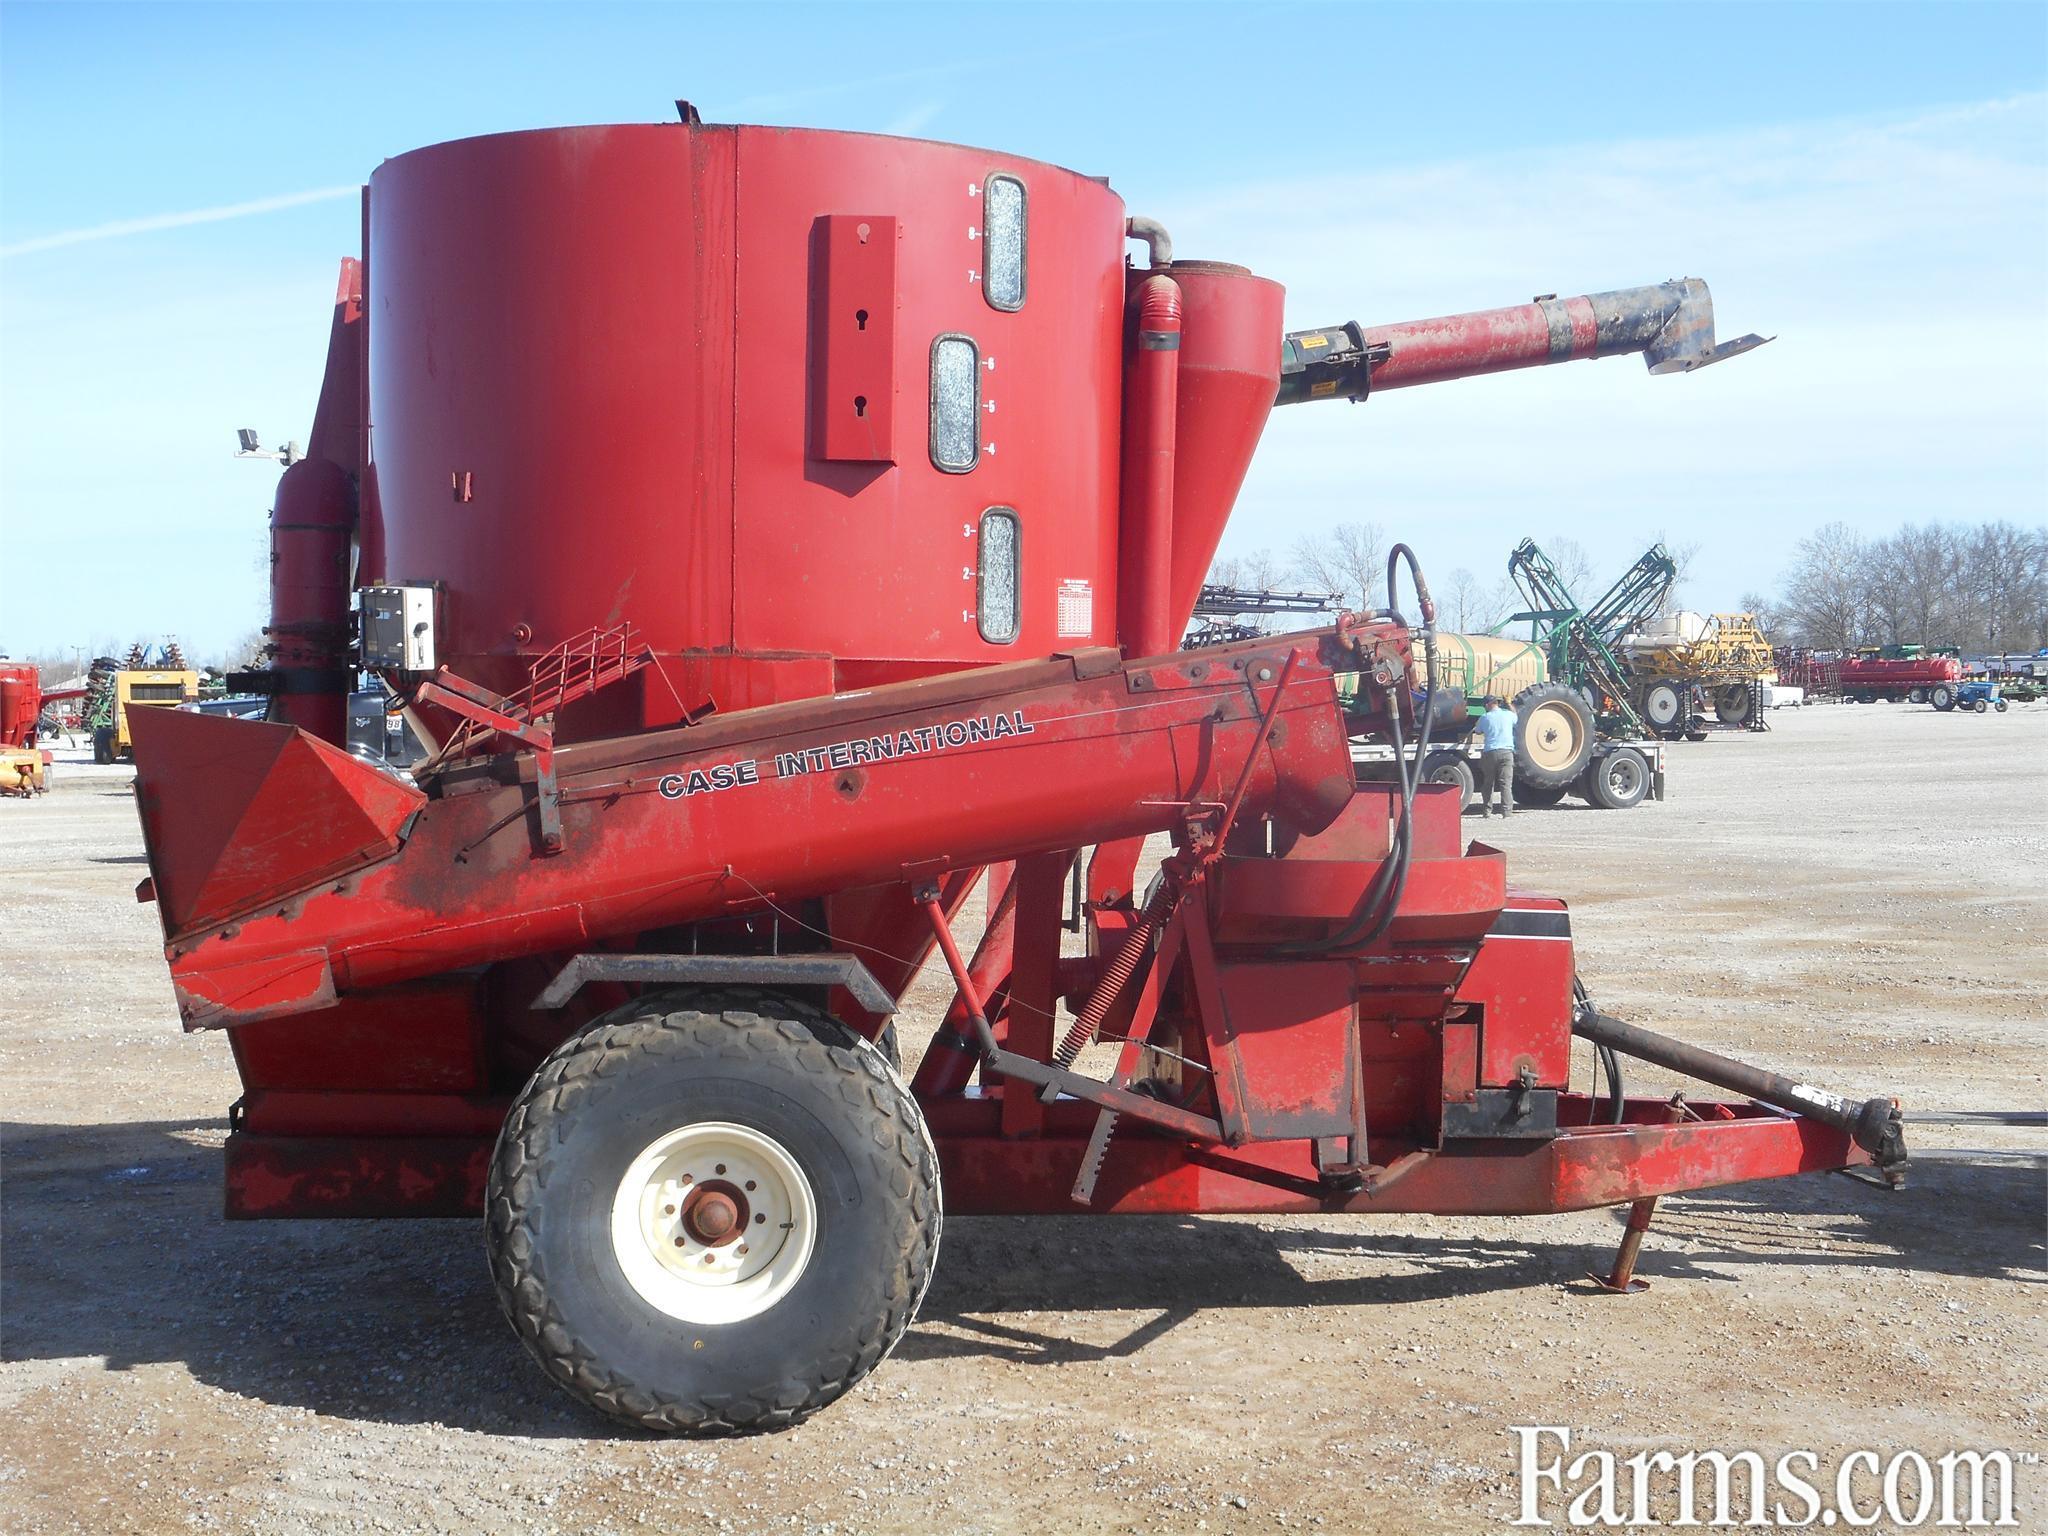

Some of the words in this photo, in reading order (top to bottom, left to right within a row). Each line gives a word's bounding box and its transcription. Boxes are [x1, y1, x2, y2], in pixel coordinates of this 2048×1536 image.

[988, 399, 996, 413] 5
[987, 442, 996, 456] 4
[963, 524, 971, 538] 3
[962, 566, 971, 580] 2
[658, 759, 759, 800] CASE
[774, 710, 1035, 779] INTERNATIONAL
